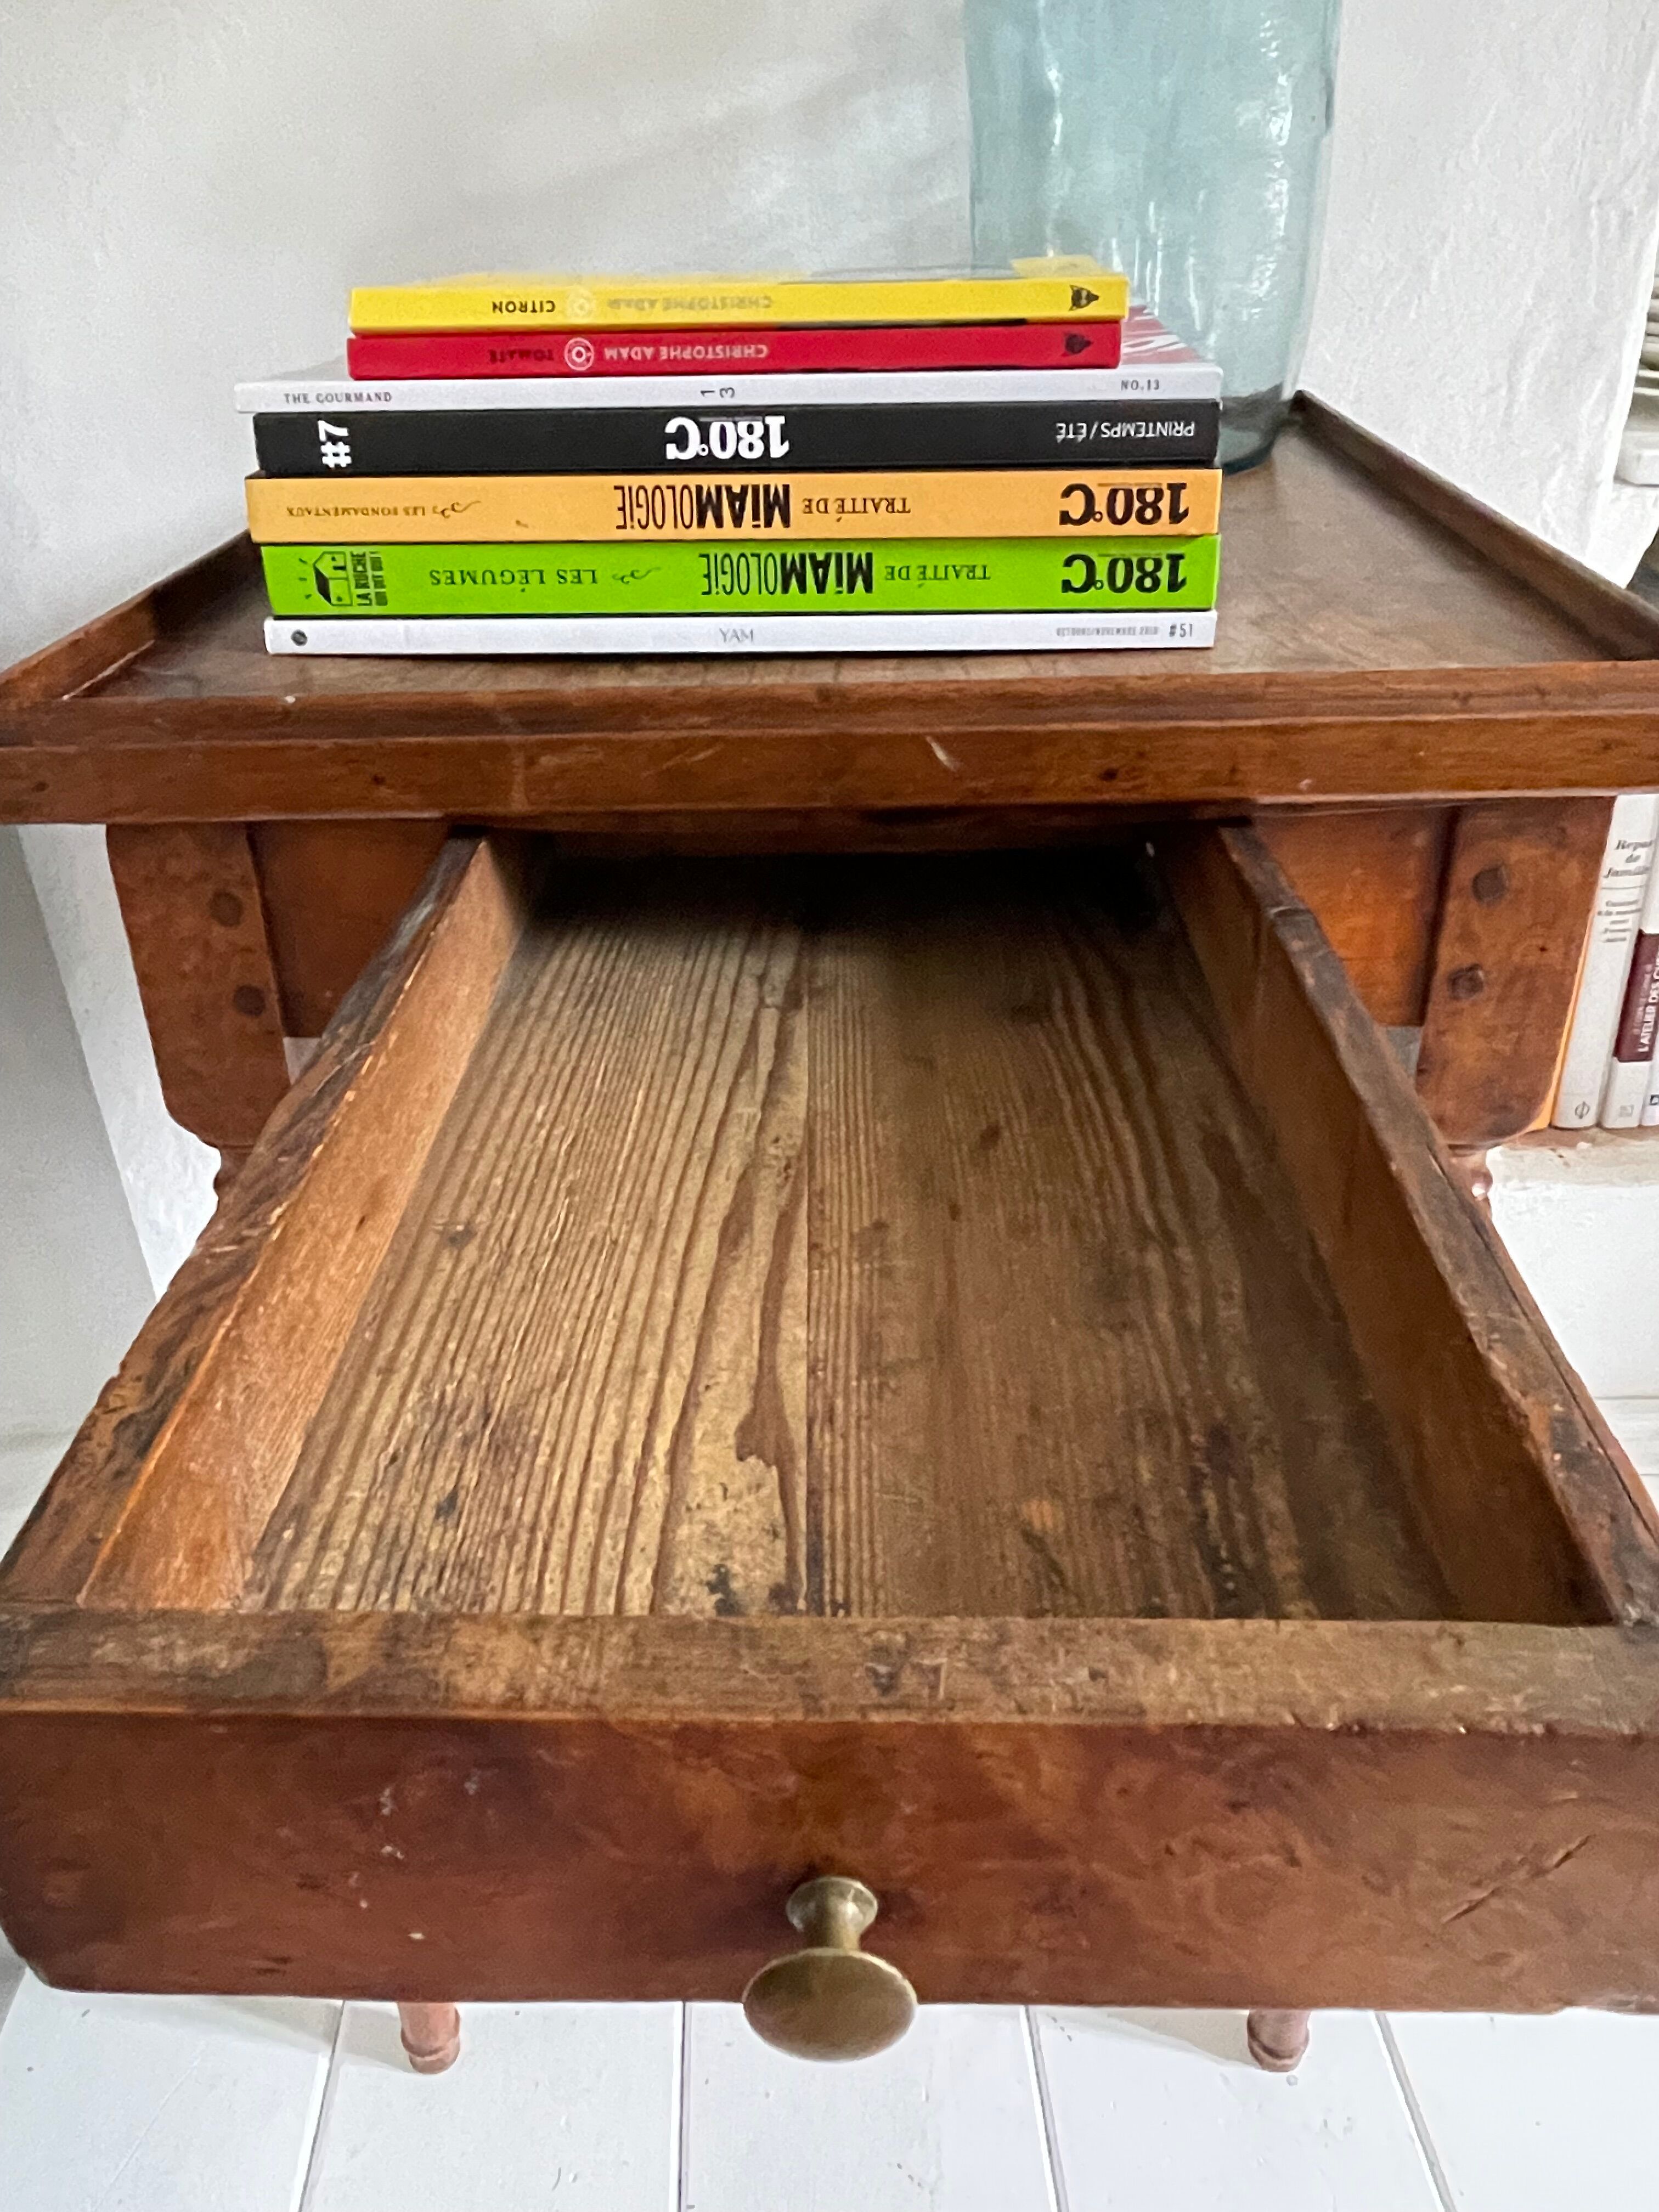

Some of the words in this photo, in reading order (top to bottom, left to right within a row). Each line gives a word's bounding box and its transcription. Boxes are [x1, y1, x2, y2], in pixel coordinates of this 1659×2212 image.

[492, 300, 555, 314] CITRON
[662, 296, 772, 313] CHRISTOPHE
[489, 349, 554, 363] TOMATE
[605, 346, 655, 361] ADAM
[659, 344, 769, 362] CHRISTOPHE
[284, 393, 311, 404] THE
[315, 392, 393, 404] GOURMAND
[664, 416, 790, 460] 180°C
[1056, 422, 1086, 443] ÉTÉ
[1101, 421, 1195, 438] PRINTEMPS
[317, 419, 352, 469] #7
[286, 506, 398, 517] FONDAMENTAUX
[403, 506, 426, 517] LES
[802, 498, 829, 515] DE
[835, 497, 911, 522] TRAITÉ
[1059, 483, 1189, 527] 180°C
[429, 569, 545, 592] LÉGUMES
[556, 568, 598, 585] LES
[884, 565, 911, 581] DE
[917, 564, 991, 588] TRAITÉ
[1061, 553, 1187, 594] 180°C
[356, 593, 373, 607] LA
[719, 628, 754, 643] YAM
